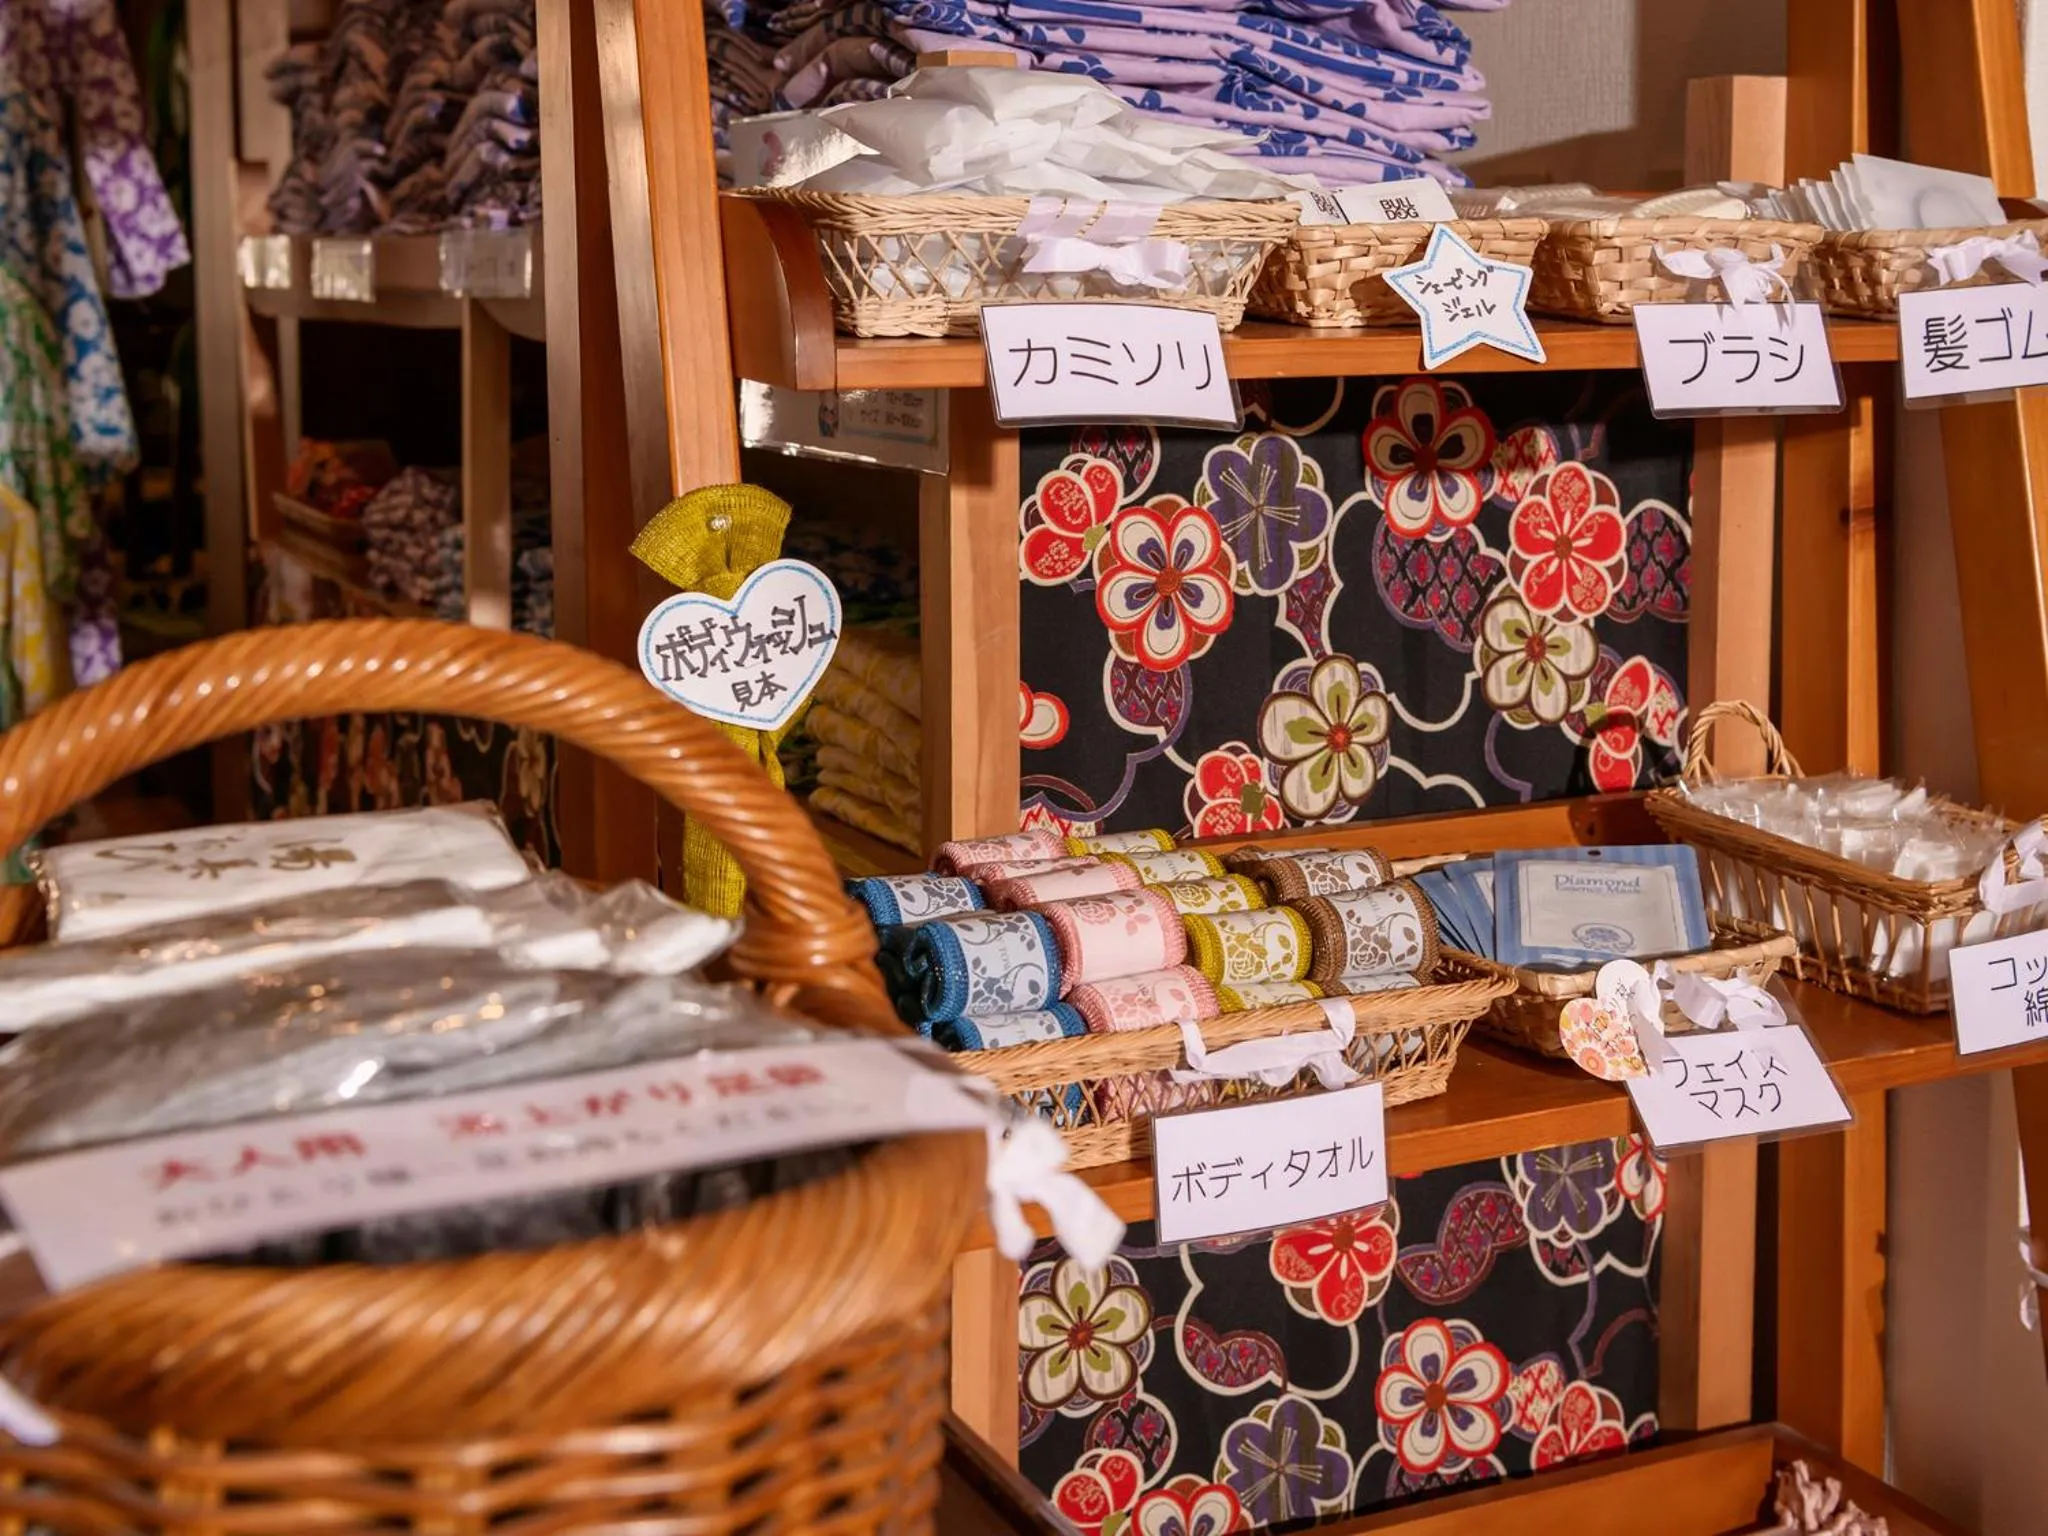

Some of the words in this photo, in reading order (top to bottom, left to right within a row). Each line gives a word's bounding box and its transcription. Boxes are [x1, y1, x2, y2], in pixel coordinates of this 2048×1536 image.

[1379, 196, 1415, 211] BULL
[1384, 208, 1420, 221] DOG
[1414, 264, 1495, 295] シェービング
[1441, 296, 1497, 323] ジェル
[1008, 337, 1212, 391] カミソリ
[1668, 330, 1804, 385] ブラシ
[730, 670, 788, 713] 見本
[1553, 872, 1641, 889] Diamond
[1689, 1082, 1782, 1120] マスク
[1171, 1135, 1374, 1203] ボディタオル
